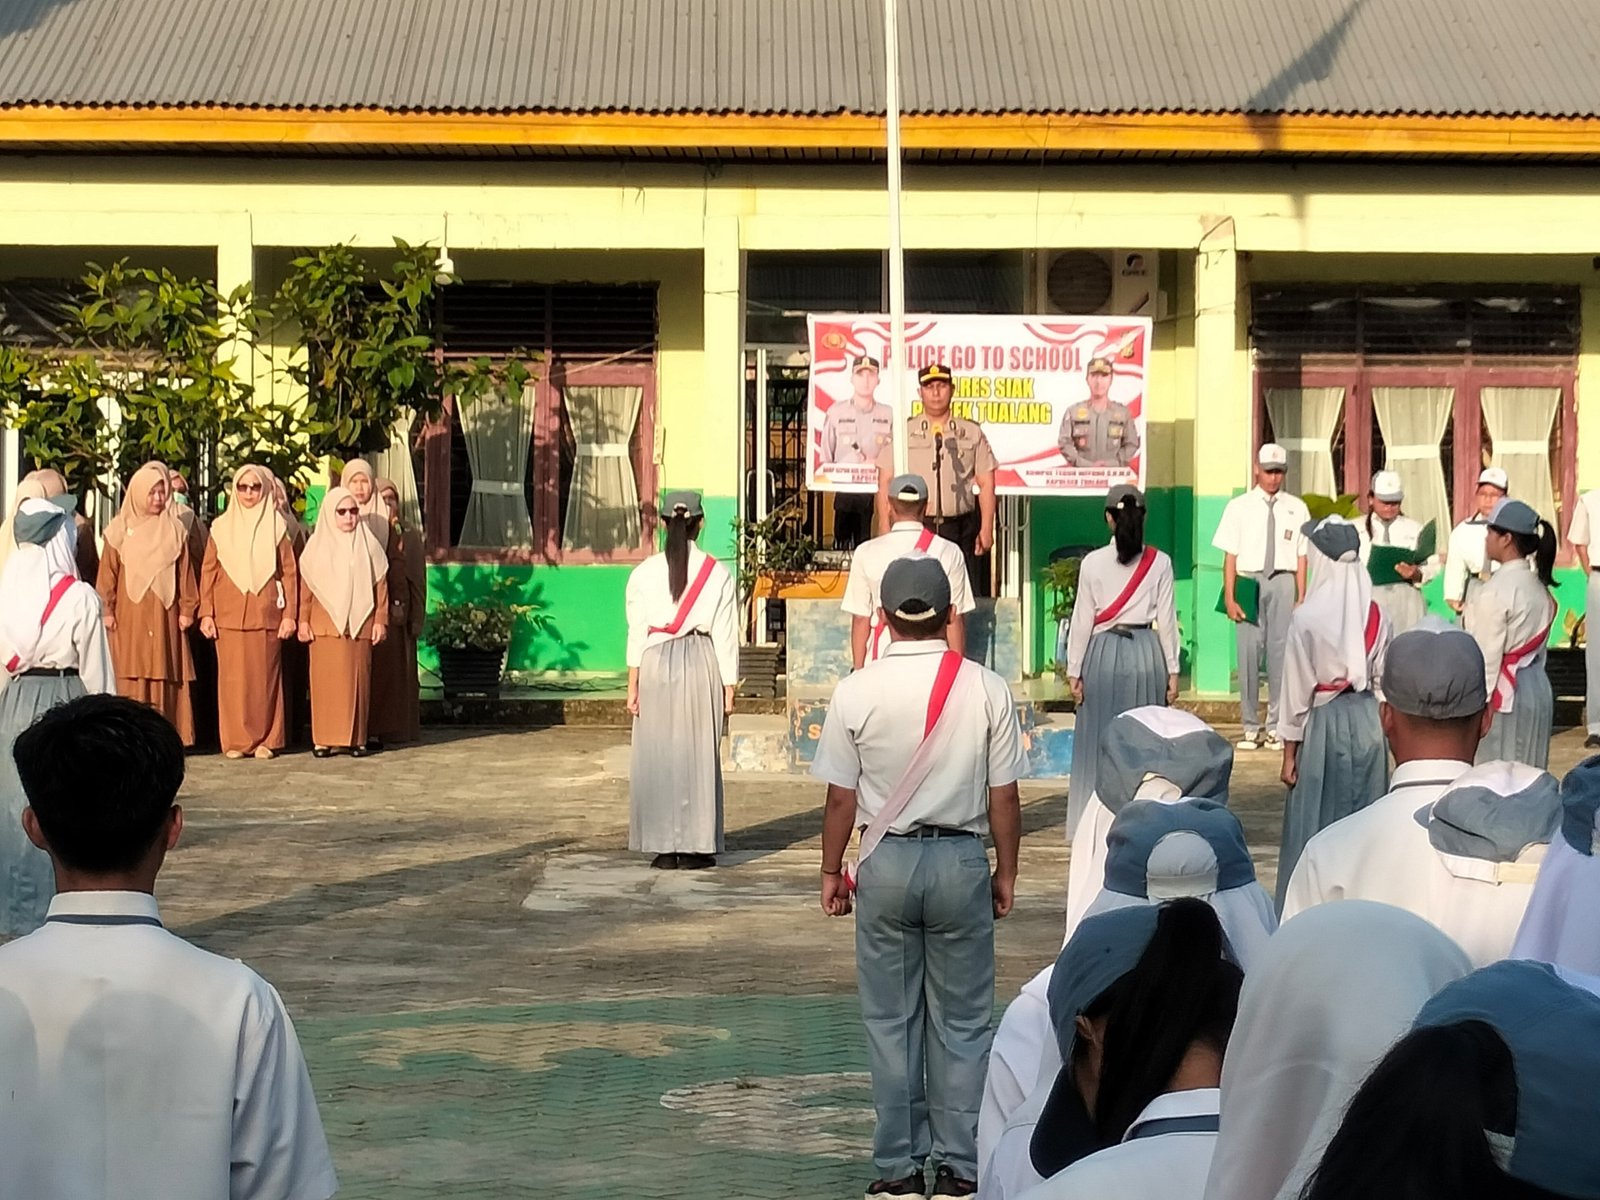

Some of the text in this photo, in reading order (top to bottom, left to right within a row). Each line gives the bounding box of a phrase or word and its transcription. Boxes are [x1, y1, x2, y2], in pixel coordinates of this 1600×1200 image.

[882, 345, 1082, 372] PLICE GO TO SCHOOL
[994, 377, 1035, 399] SIAK
[976, 401, 1053, 424] TUALANG
